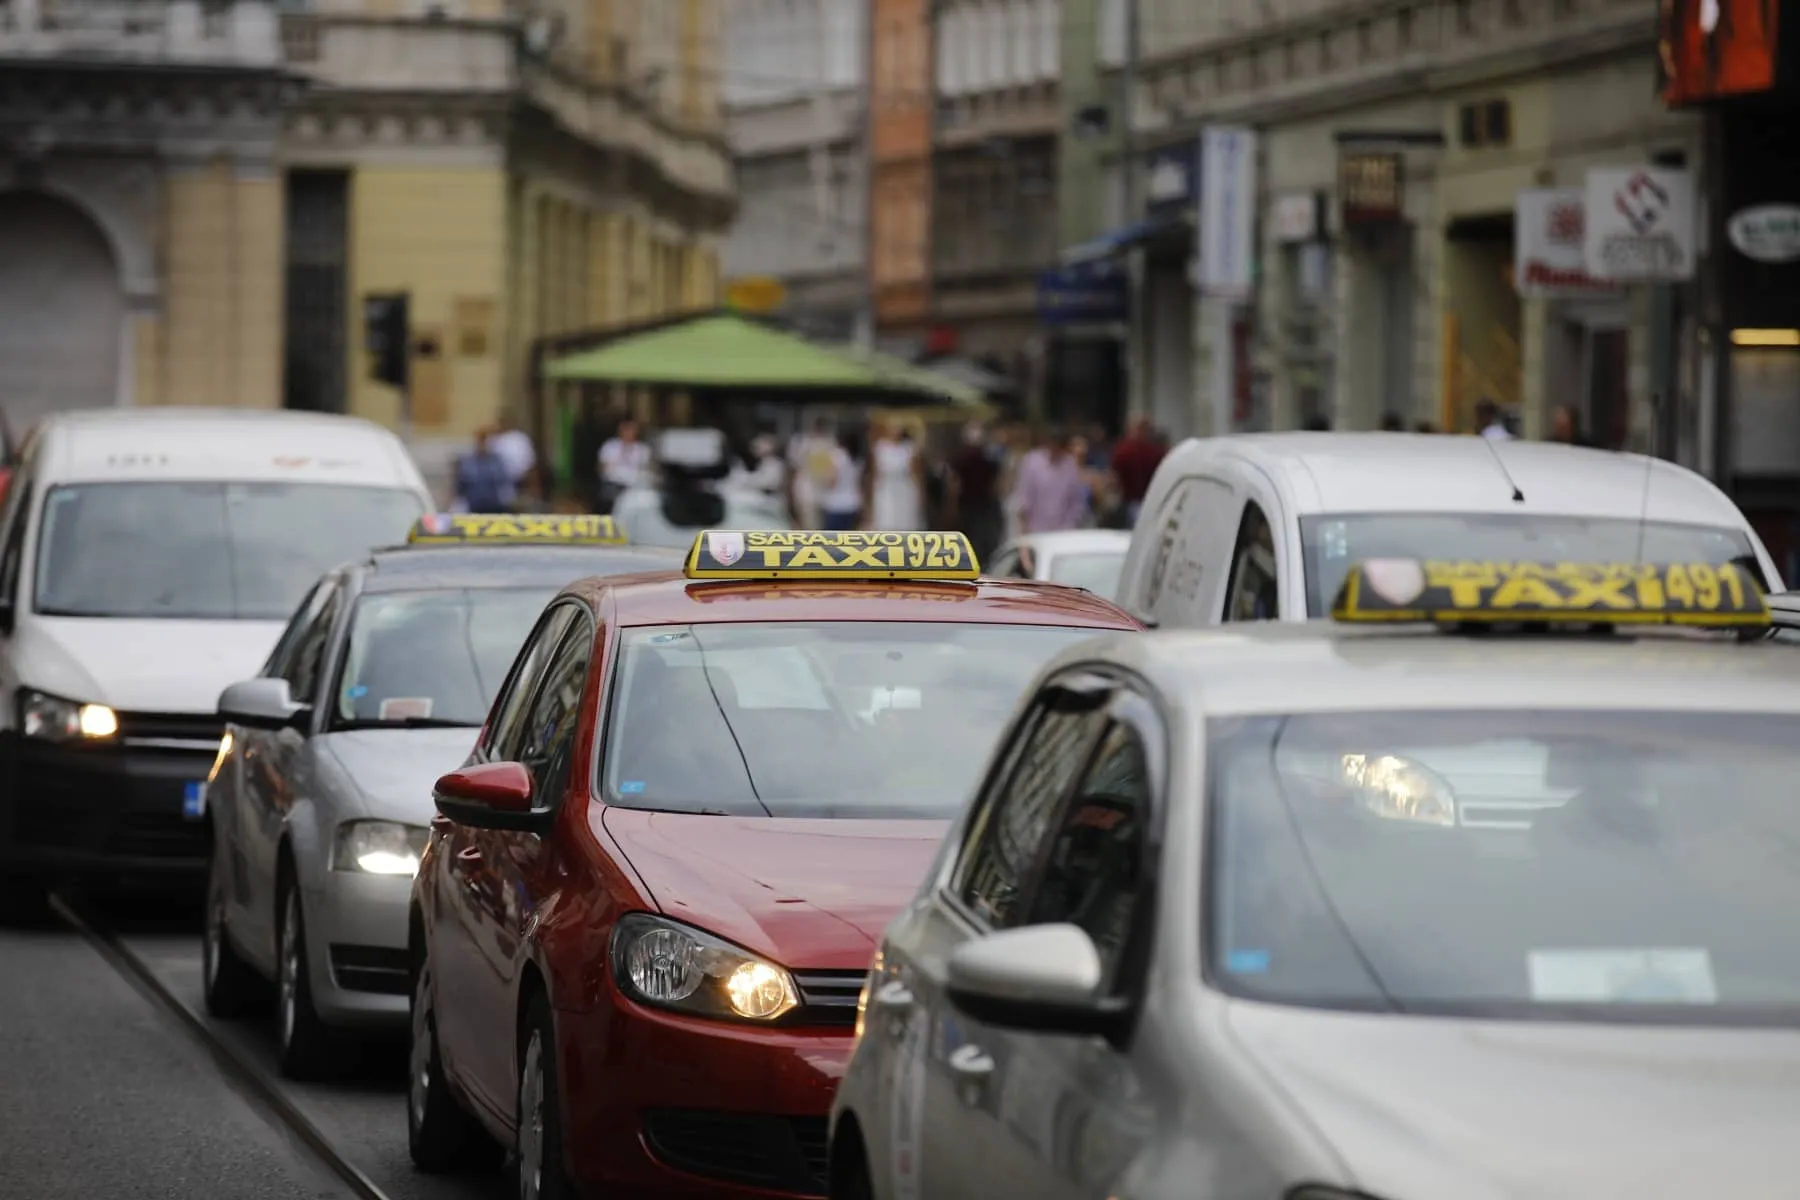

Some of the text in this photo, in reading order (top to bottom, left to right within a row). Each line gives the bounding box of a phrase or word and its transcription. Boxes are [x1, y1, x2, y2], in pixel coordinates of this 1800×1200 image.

[454, 517, 571, 537] TAXI
[748, 532, 903, 546] SARAJEVO
[748, 533, 961, 567] TAXI 925
[1428, 562, 1745, 610] TAXI 491
